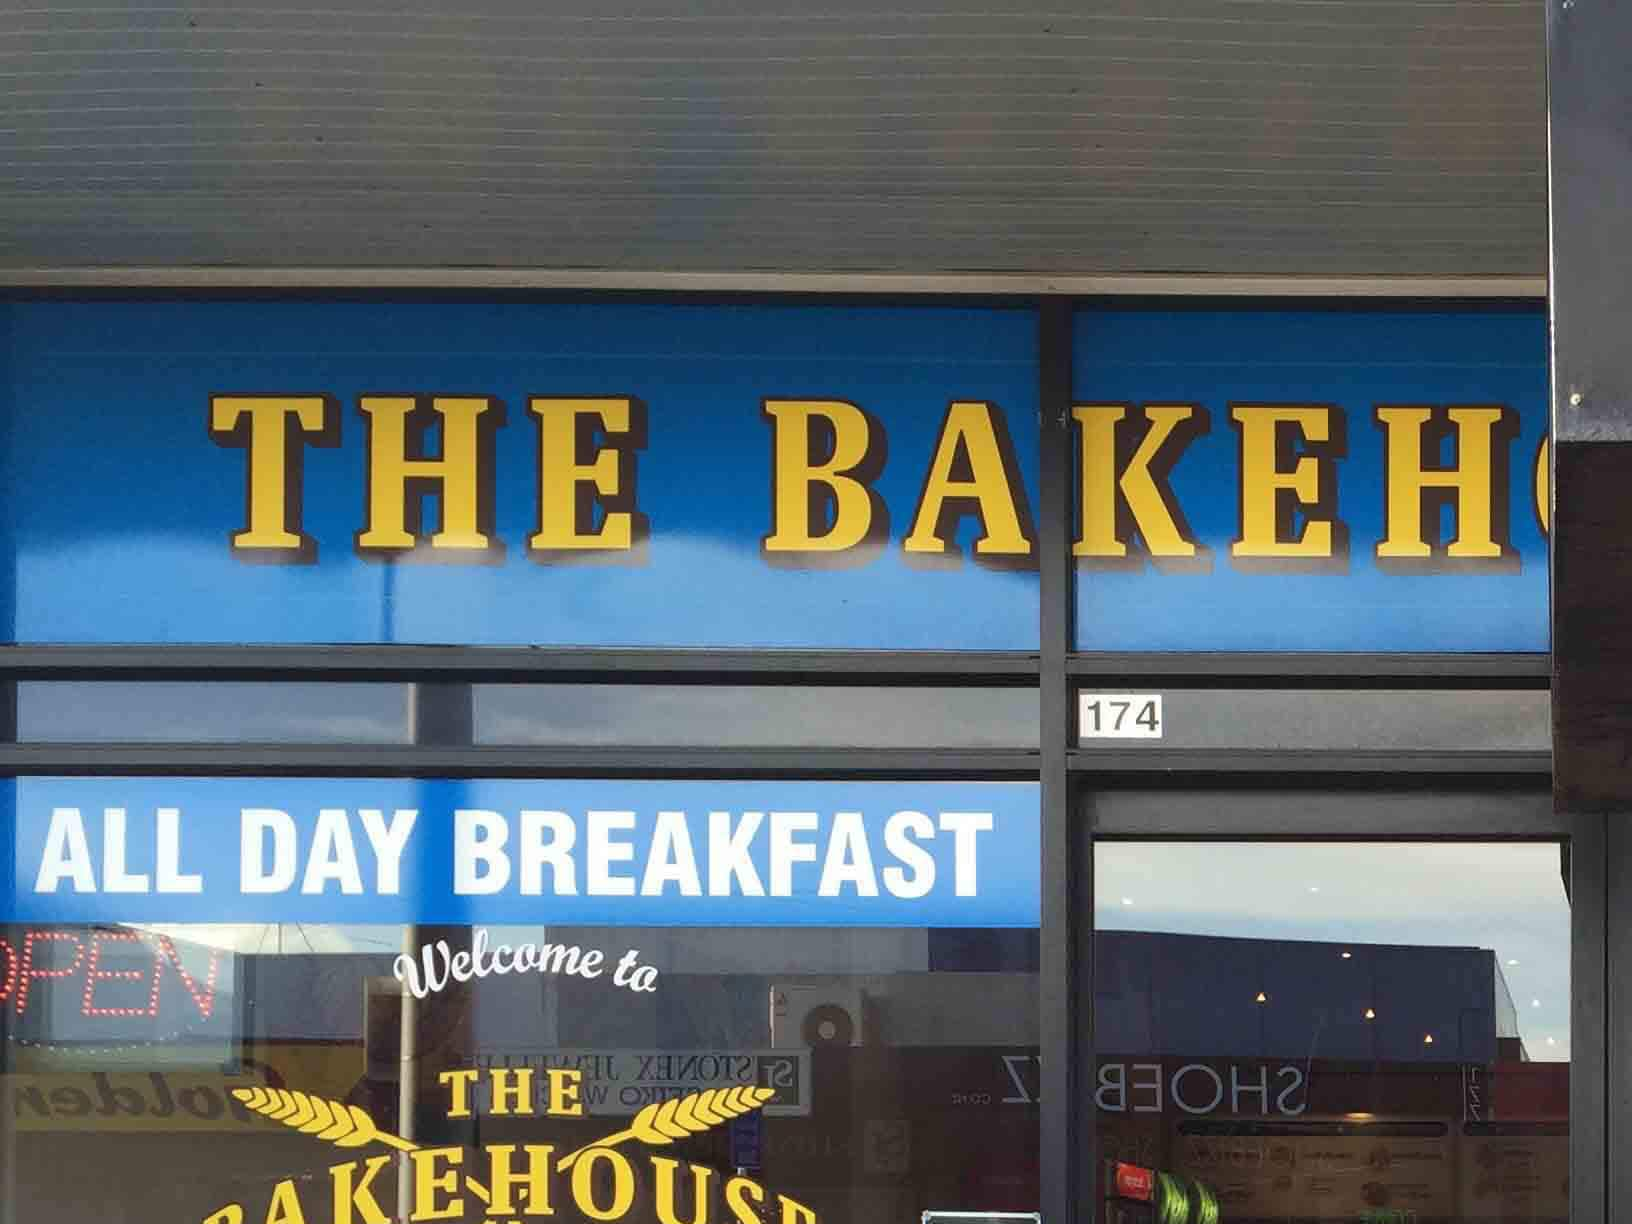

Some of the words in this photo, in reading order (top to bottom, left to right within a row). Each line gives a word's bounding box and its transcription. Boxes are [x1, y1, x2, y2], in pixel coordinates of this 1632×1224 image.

[213, 397, 632, 549] THE
[1087, 700, 1160, 731] 174
[35, 807, 202, 893] ALL
[240, 809, 417, 894] DAY
[454, 810, 993, 898] BREAKFAST
[393, 928, 602, 999] Welcome
[612, 950, 659, 993] to
[438, 1068, 583, 1117] THE
